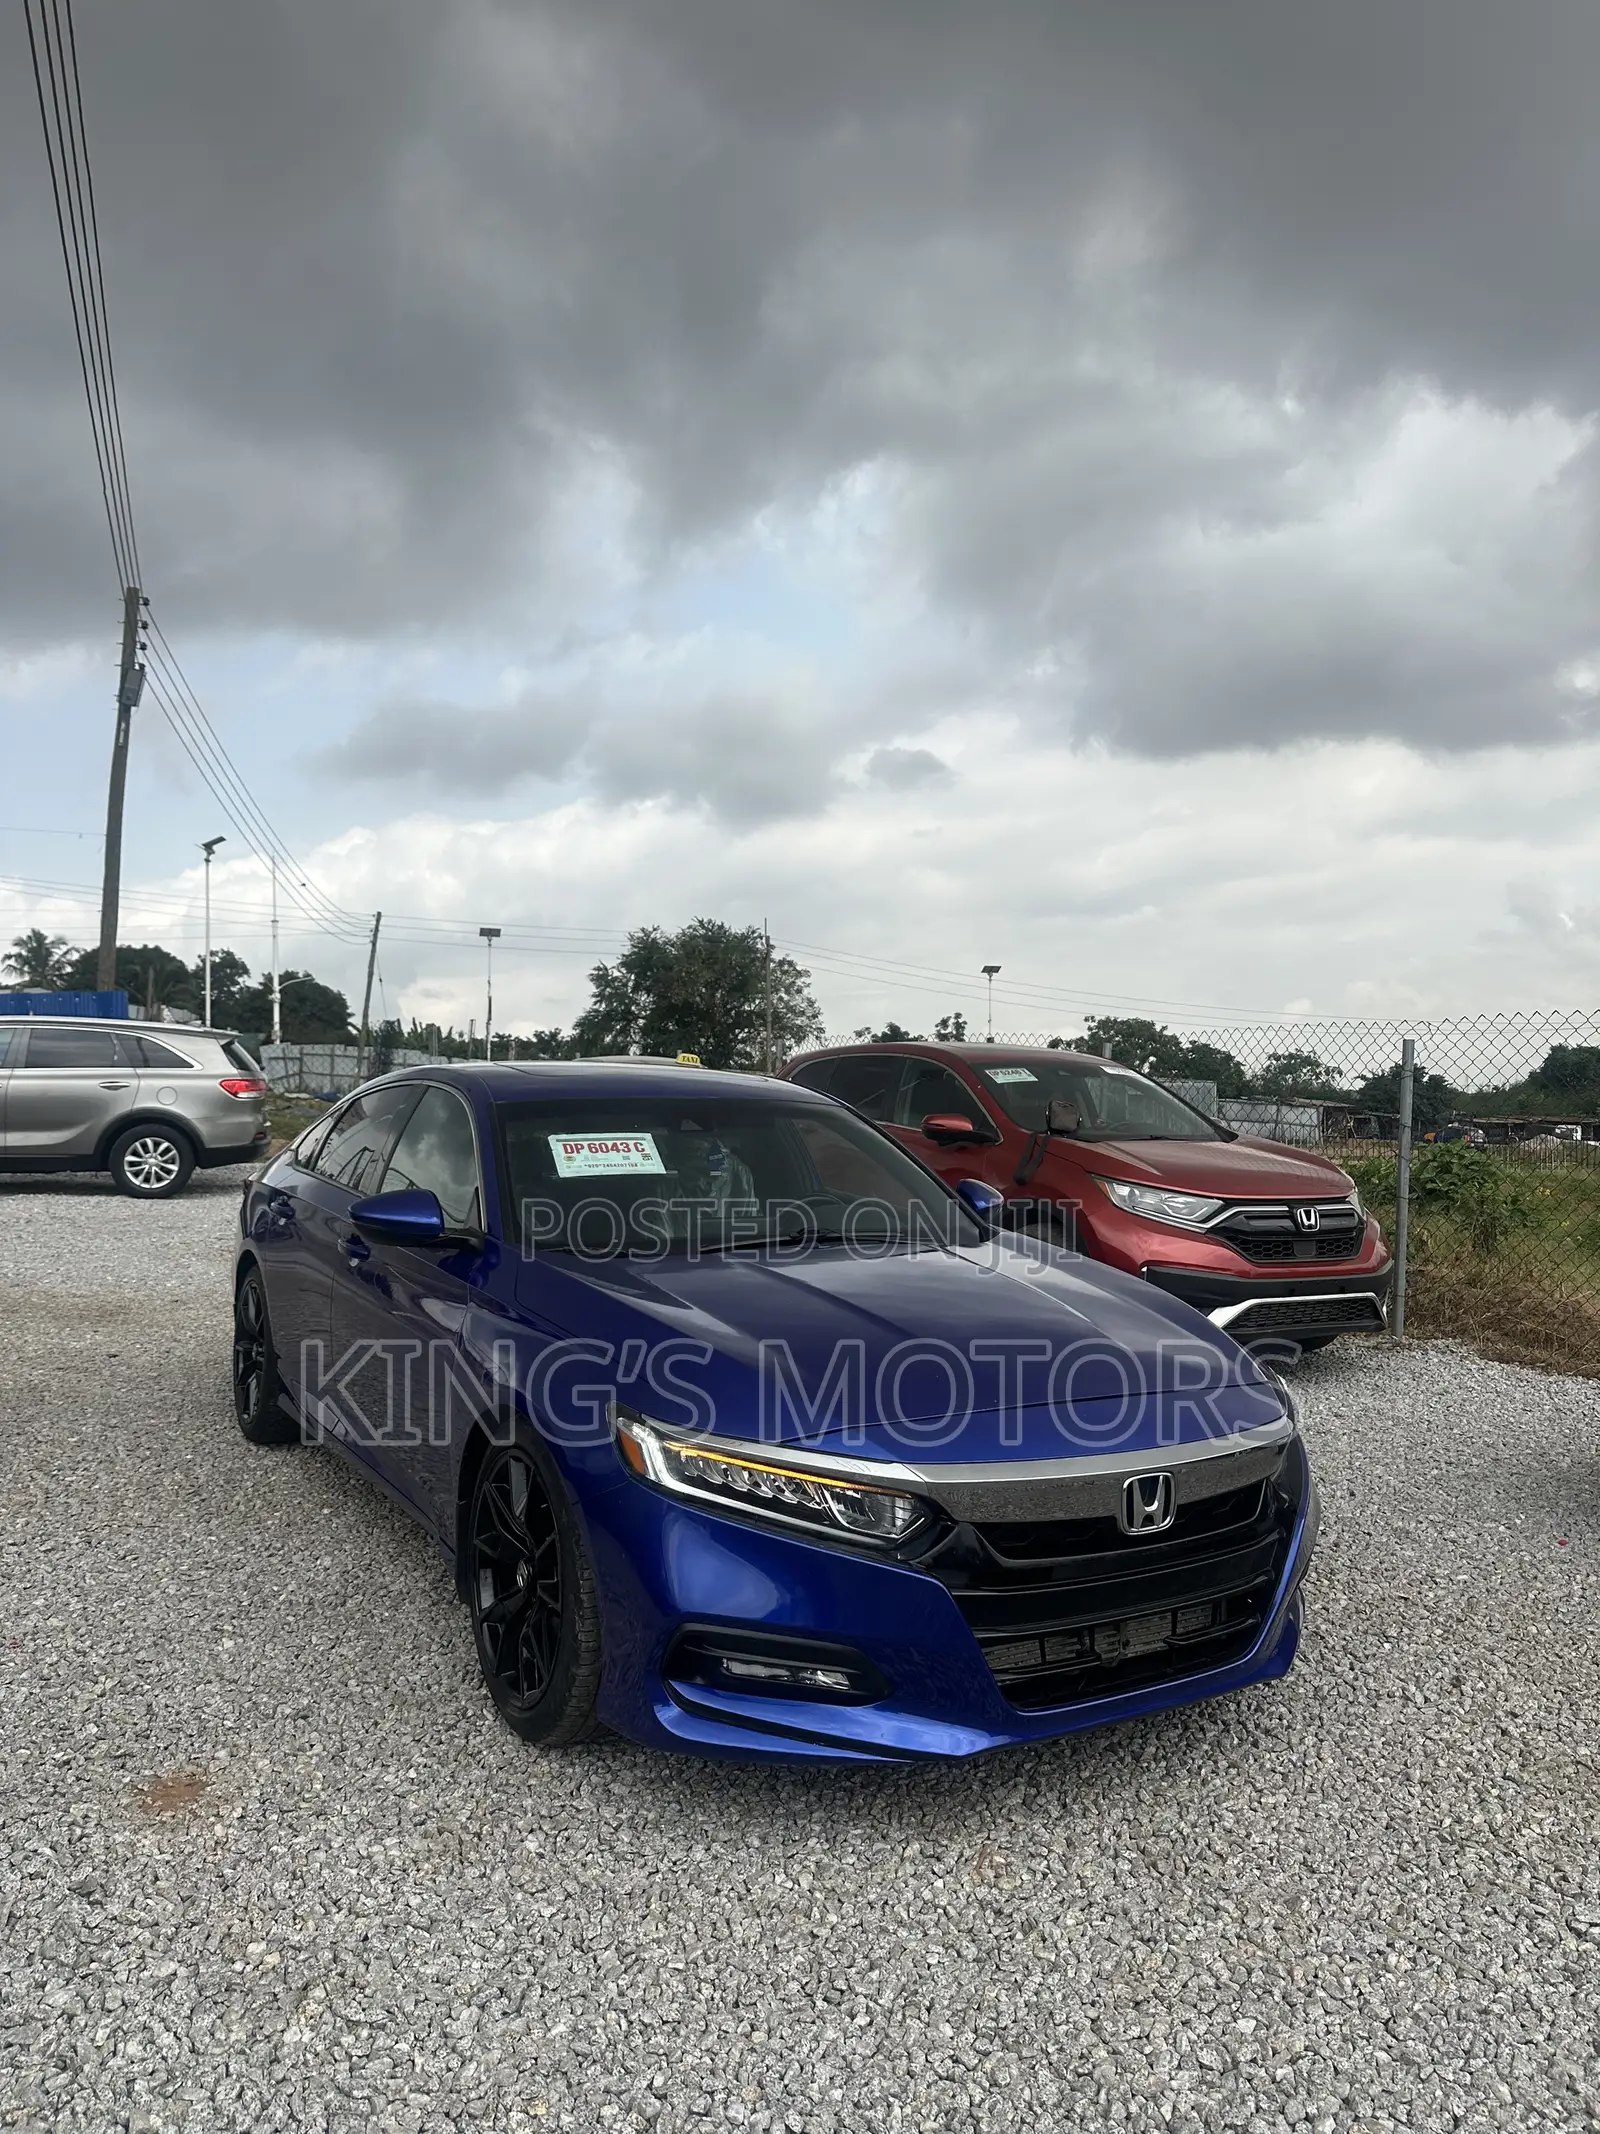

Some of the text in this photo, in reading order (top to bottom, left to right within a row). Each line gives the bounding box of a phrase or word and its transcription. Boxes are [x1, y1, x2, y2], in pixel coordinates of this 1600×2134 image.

[681, 1055, 698, 1064] TAXI
[562, 1142, 645, 1154] DP 6043 C
